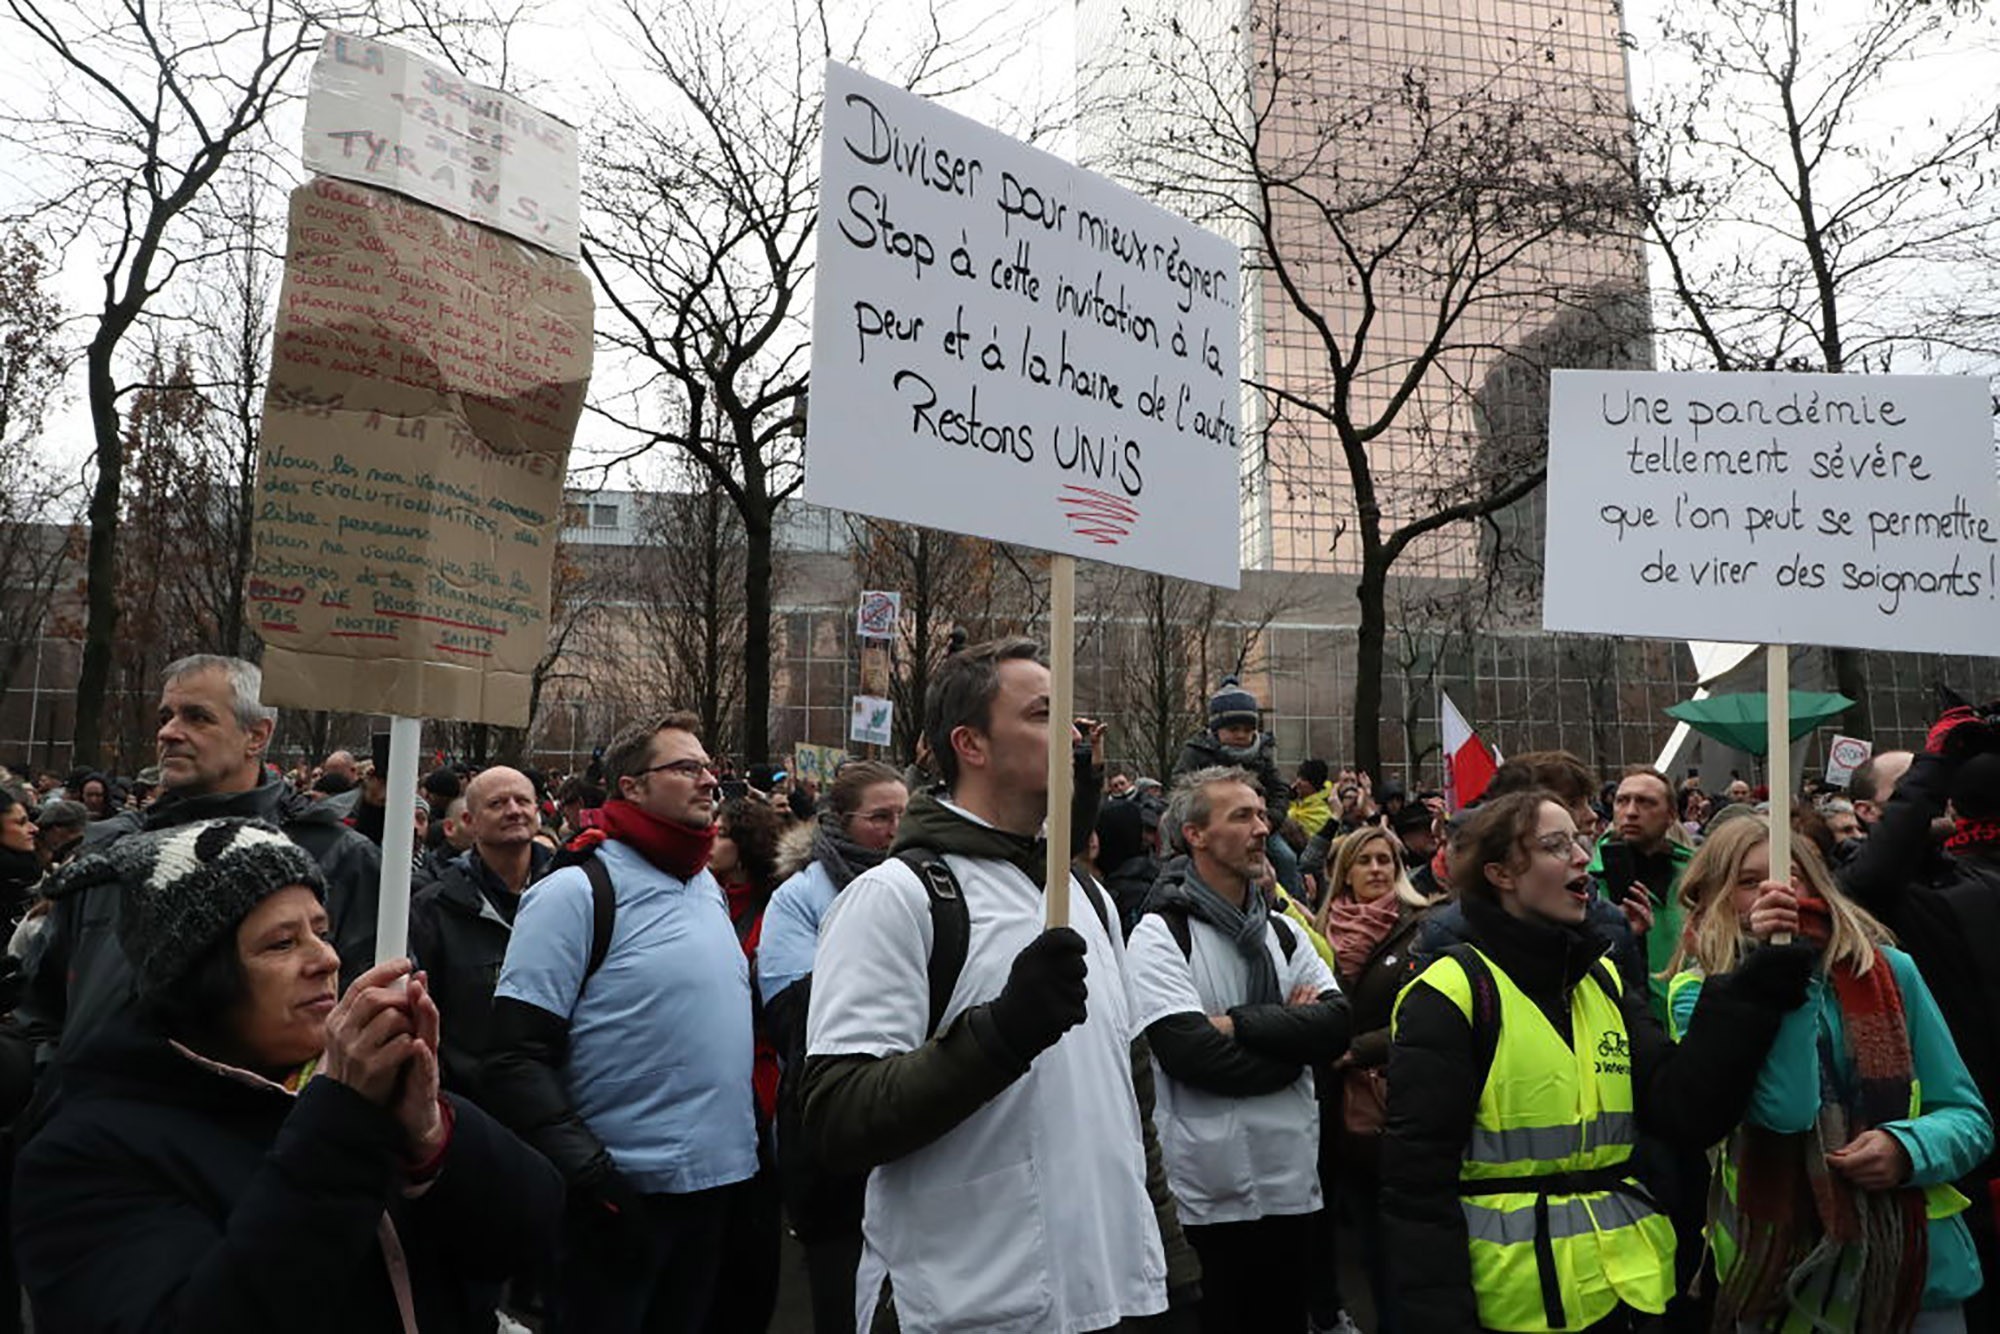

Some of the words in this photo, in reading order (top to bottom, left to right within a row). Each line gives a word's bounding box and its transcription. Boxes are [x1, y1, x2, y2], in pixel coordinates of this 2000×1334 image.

[844, 93, 983, 198] Diviser
[997, 171, 1068, 237] pour
[1077, 209, 1145, 271] mieux
[838, 184, 934, 280] Stop
[950, 228, 976, 280] à
[991, 239, 1040, 301] cette
[1055, 270, 1160, 350] invitation
[1172, 321, 1188, 357] à
[1202, 328, 1224, 377] la
[943, 305, 970, 360] et
[980, 326, 1006, 372] à
[1021, 326, 1052, 386] la
[1059, 330, 1124, 410] haine
[1137, 375, 1166, 423] de
[1175, 383, 1240, 449] l'autre
[396, 413, 428, 441] LA
[893, 369, 1035, 463] Restons
[1601, 389, 1674, 426] Une
[1688, 391, 1908, 443] pandémie
[1626, 437, 1789, 476] tellement
[1809, 440, 1933, 481] sévère
[1600, 503, 1660, 542] que
[1675, 491, 1730, 530] l'on
[1744, 489, 1804, 544] peut
[1817, 511, 1855, 537] se
[1868, 494, 1998, 551] permettre
[1639, 550, 1680, 584] de
[1690, 556, 1759, 587] virer
[1776, 553, 1826, 589] des
[257, 601, 298, 624] PAS
[335, 616, 400, 633] NOTRE
